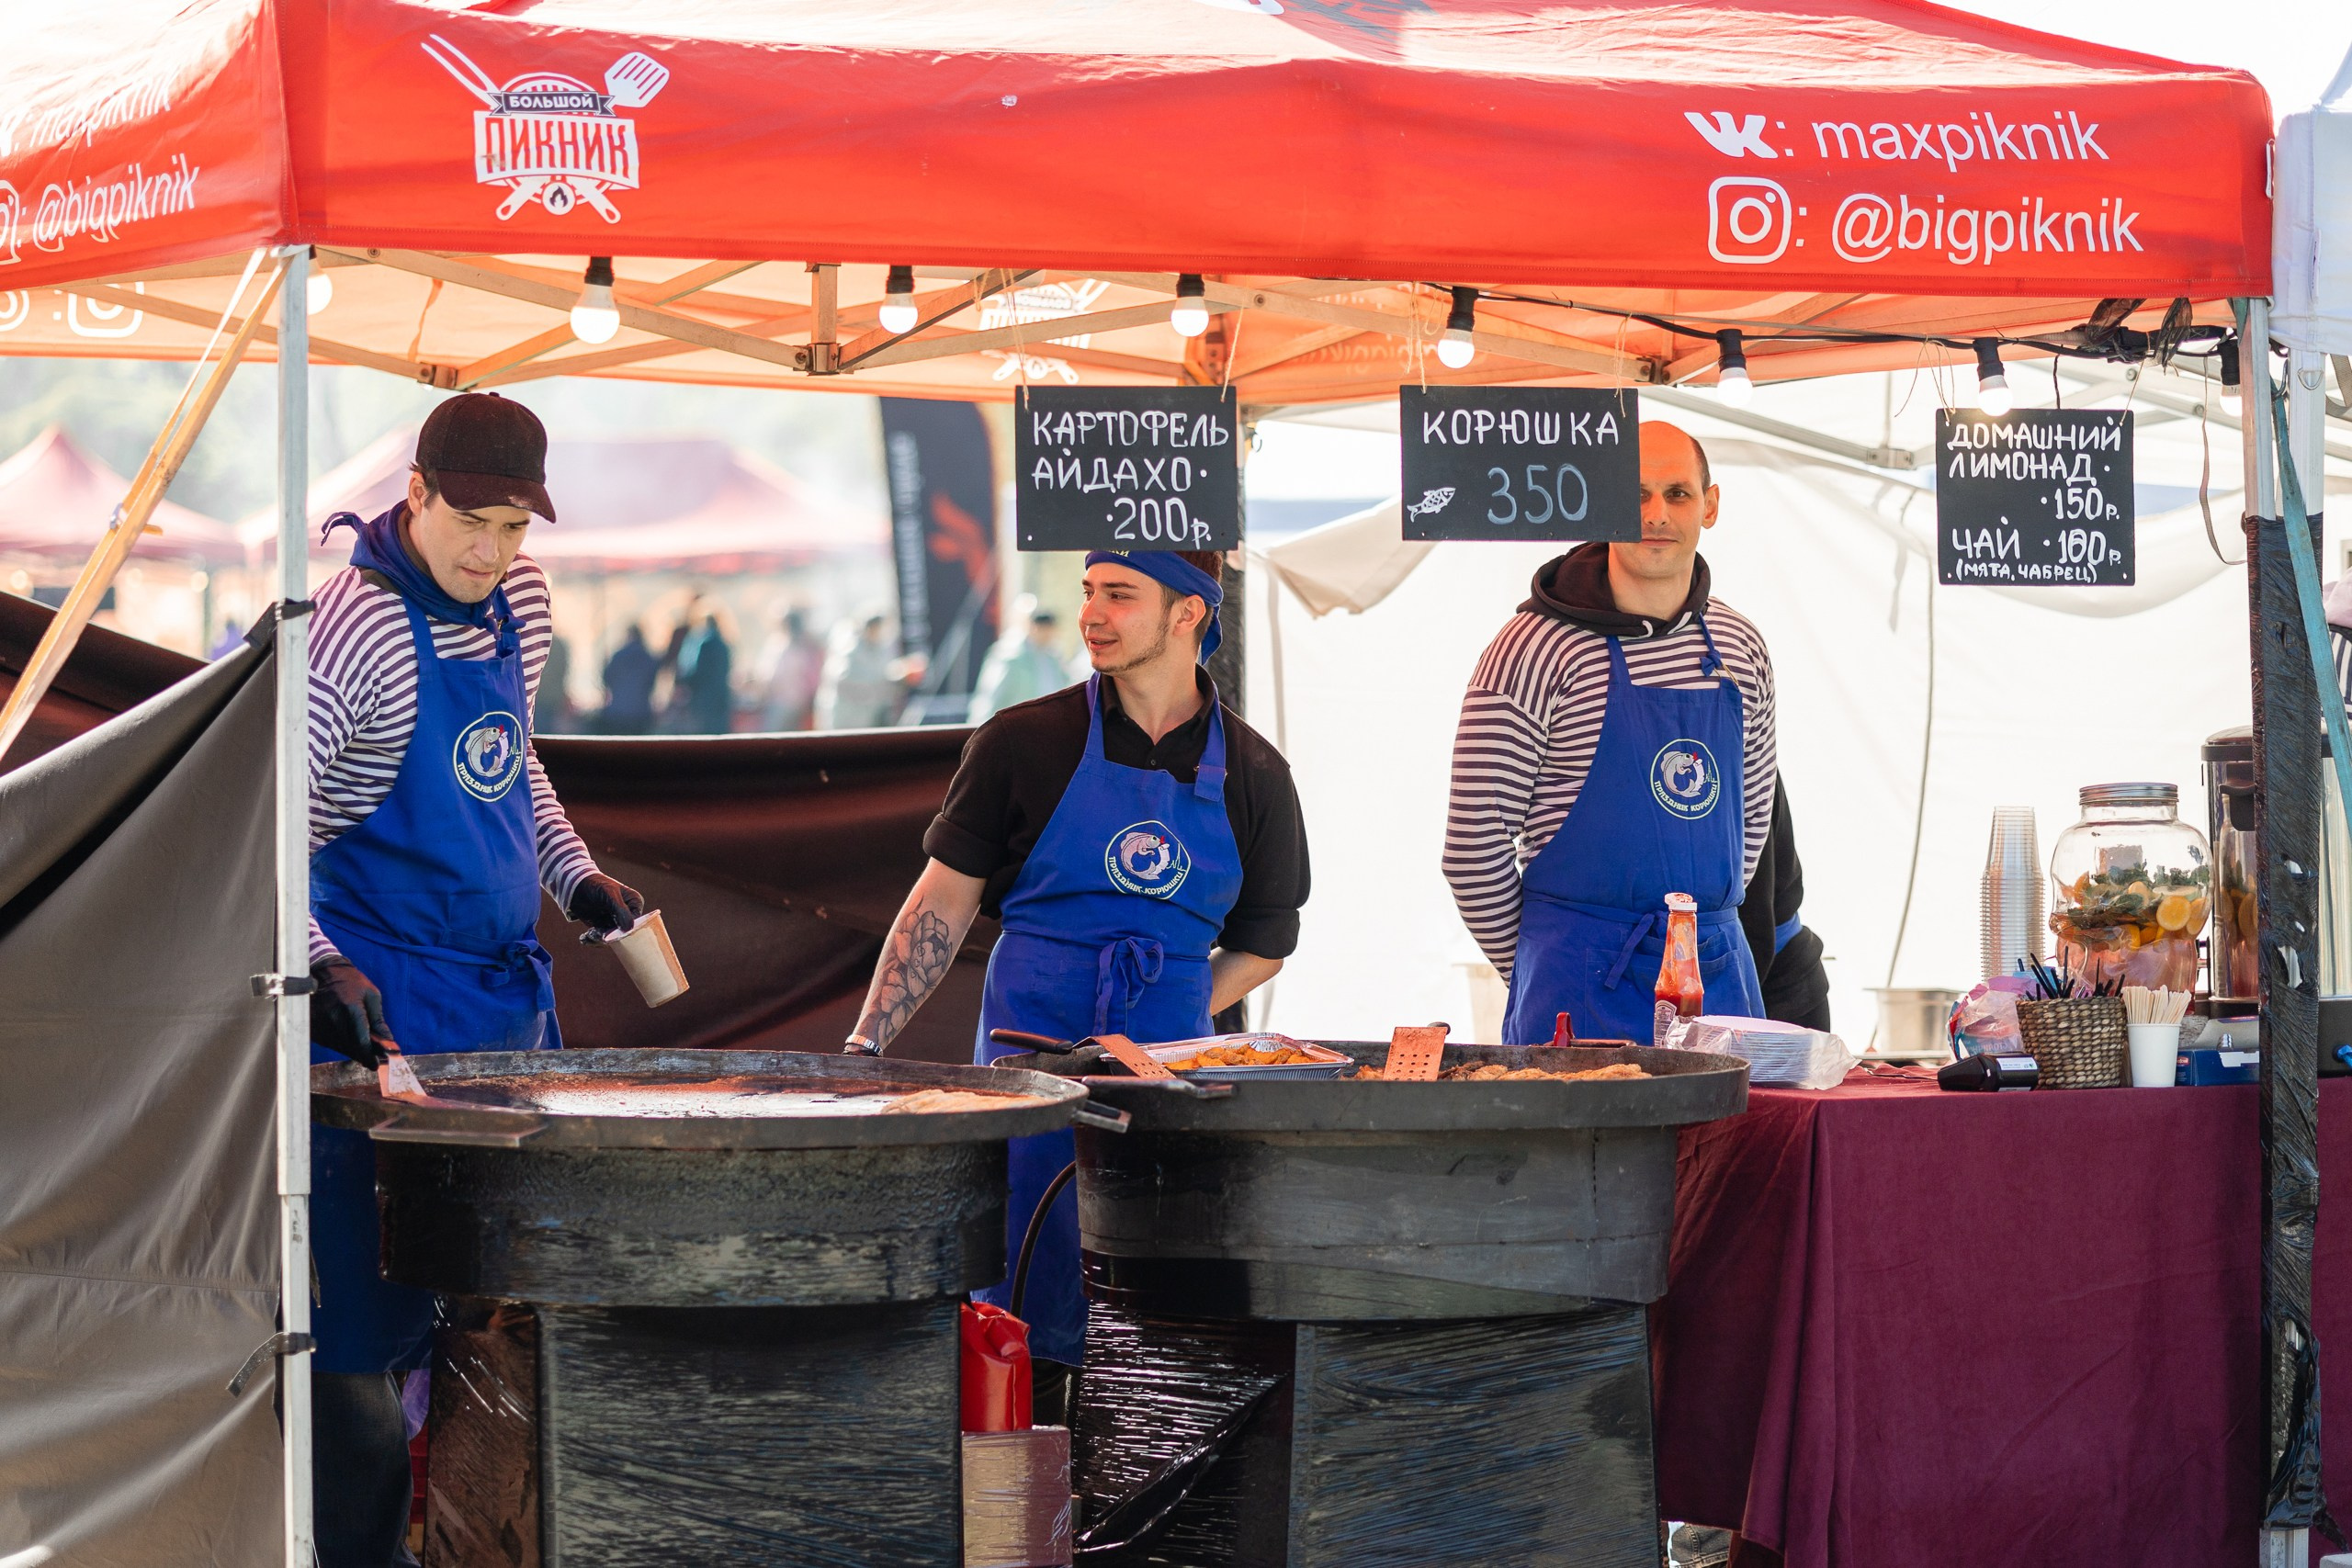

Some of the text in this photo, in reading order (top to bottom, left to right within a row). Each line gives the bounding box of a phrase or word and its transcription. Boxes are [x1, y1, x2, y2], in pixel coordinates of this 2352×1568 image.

[508, 93, 594, 109] БОЛЬШОЙ
[484, 117, 631, 180] ПИКНИК
[1811, 110, 2110, 173] maxpiknik
[33, 152, 200, 253] @bigpiknik
[1831, 193, 2144, 265] @bigpiknik
[1033, 410, 1229, 448] КАРТОФЕЛЬ
[1423, 409, 1619, 446] КОРЮШКА
[1947, 416, 2122, 452] ДОМАШНИЙ
[1487, 463, 1589, 525] 350
[1951, 515, 2021, 559] ЧАЙ
